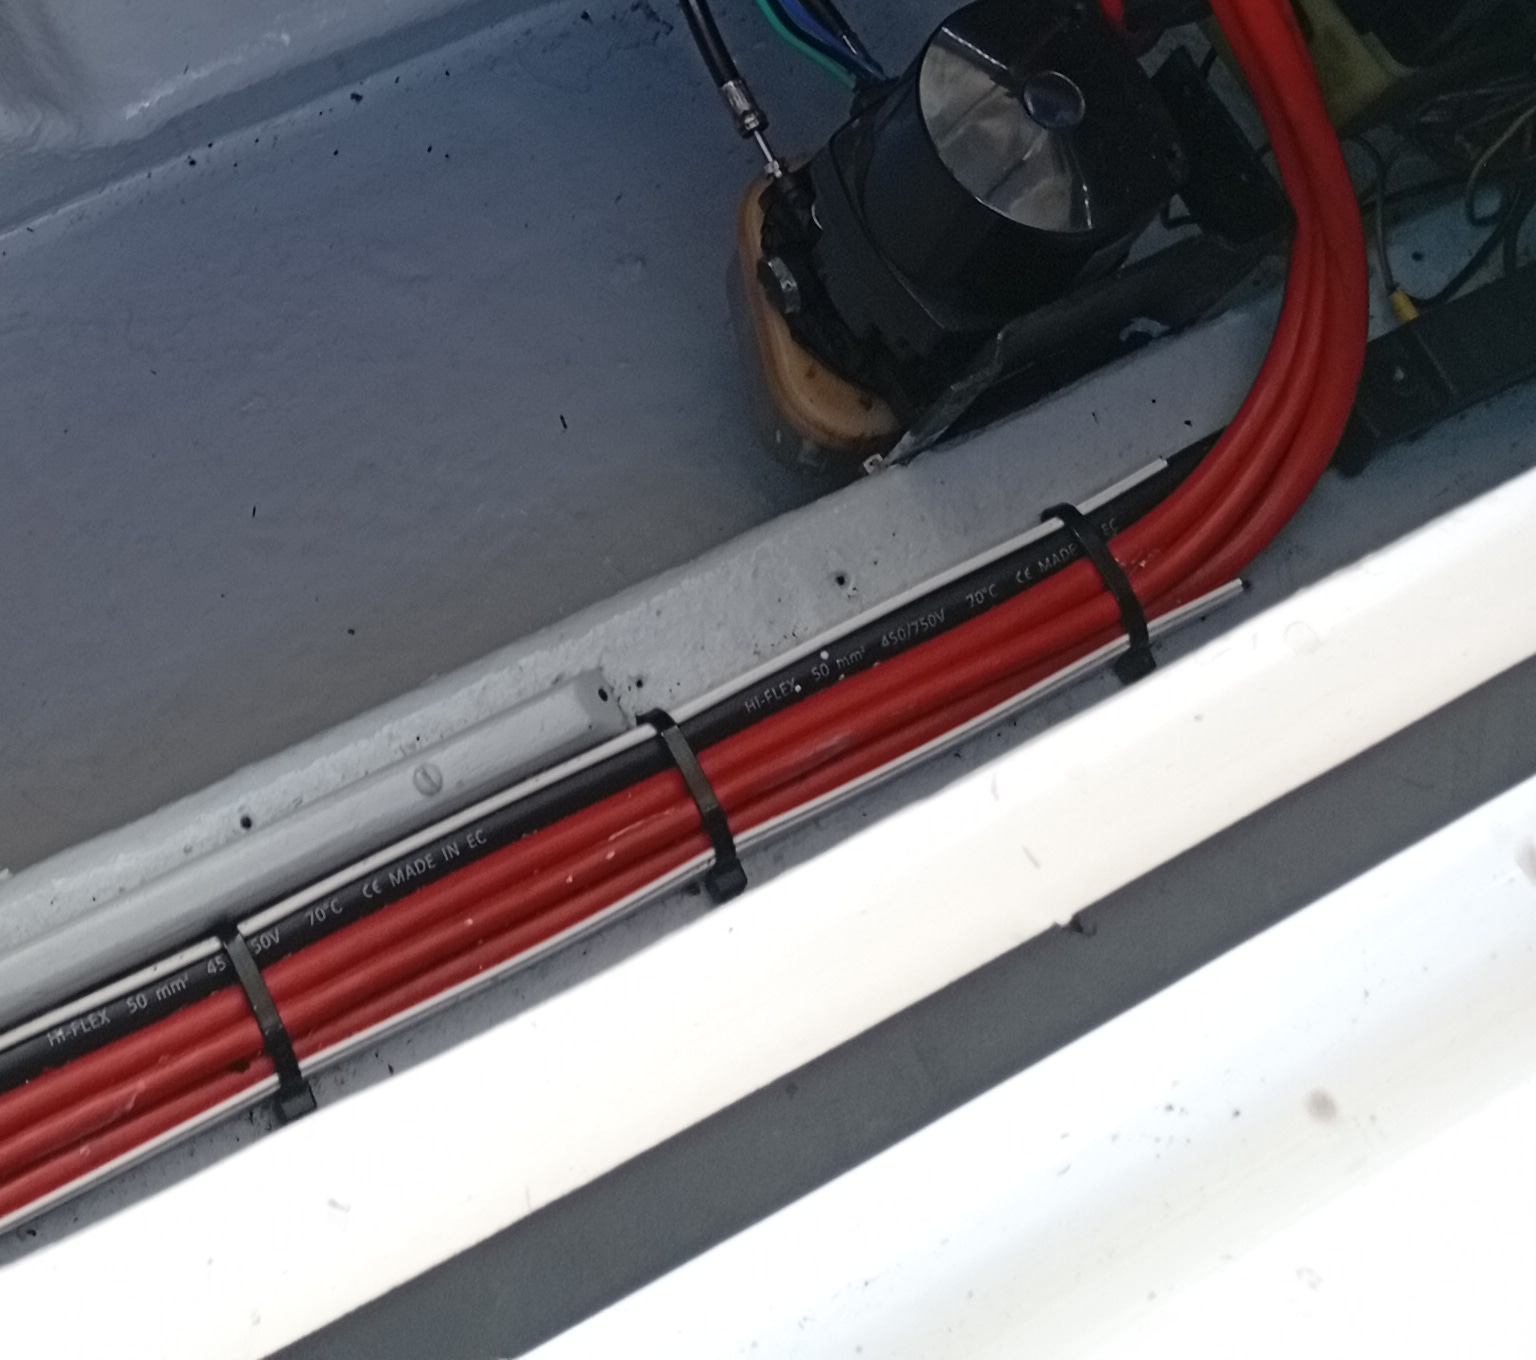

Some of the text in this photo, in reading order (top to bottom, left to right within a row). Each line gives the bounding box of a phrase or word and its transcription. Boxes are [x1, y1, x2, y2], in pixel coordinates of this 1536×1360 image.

[744, 677, 796, 713] HI-FLEX
[811, 663, 830, 682] 50
[881, 608, 945, 648] 450/750V
[965, 583, 997, 608] 70°C
[46, 1010, 111, 1047] HI-FLEX
[126, 995, 147, 1014] 50
[305, 898, 343, 926] 70°C
[388, 855, 437, 887] MADE
[442, 842, 460, 861] IN
[467, 829, 487, 848] EC
